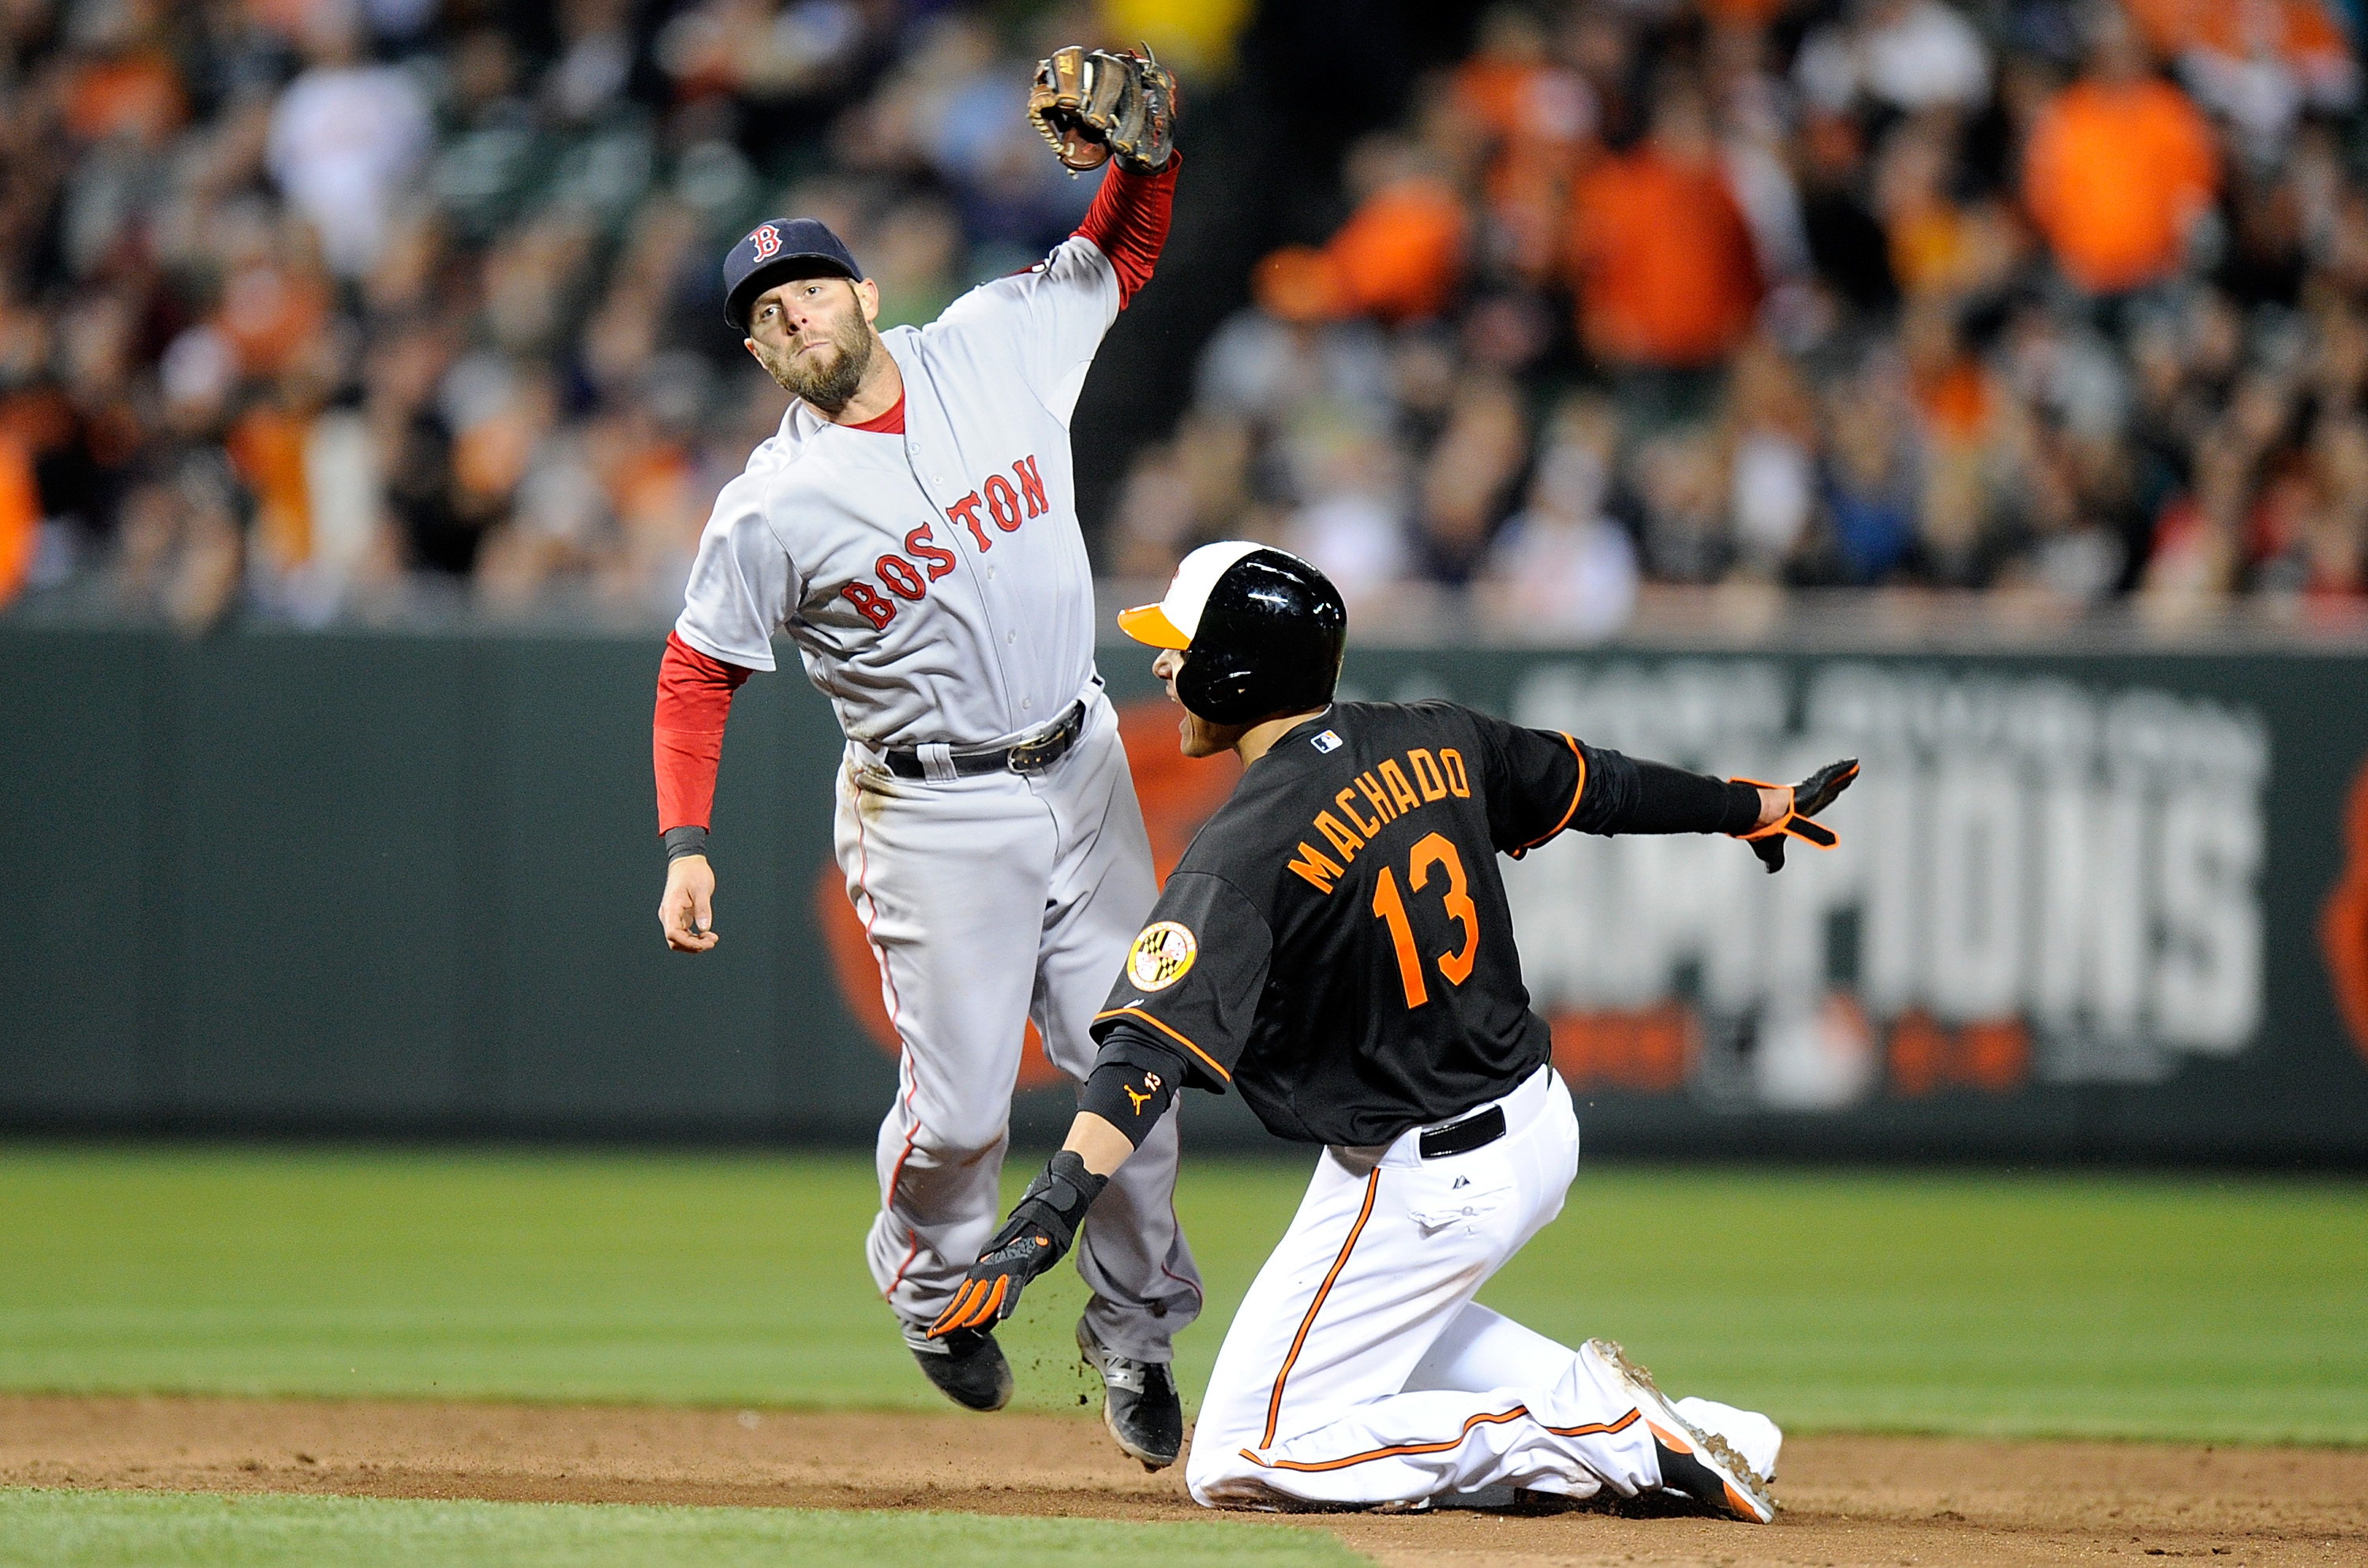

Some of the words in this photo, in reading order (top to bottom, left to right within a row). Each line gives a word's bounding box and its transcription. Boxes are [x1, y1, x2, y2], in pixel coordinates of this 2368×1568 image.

[749, 224, 782, 263] B
[841, 455, 1049, 630] BOSTON
[1287, 747, 1471, 895] MACHADO
[1371, 831, 1480, 1010] 13
[1144, 1071, 1161, 1092] 13
